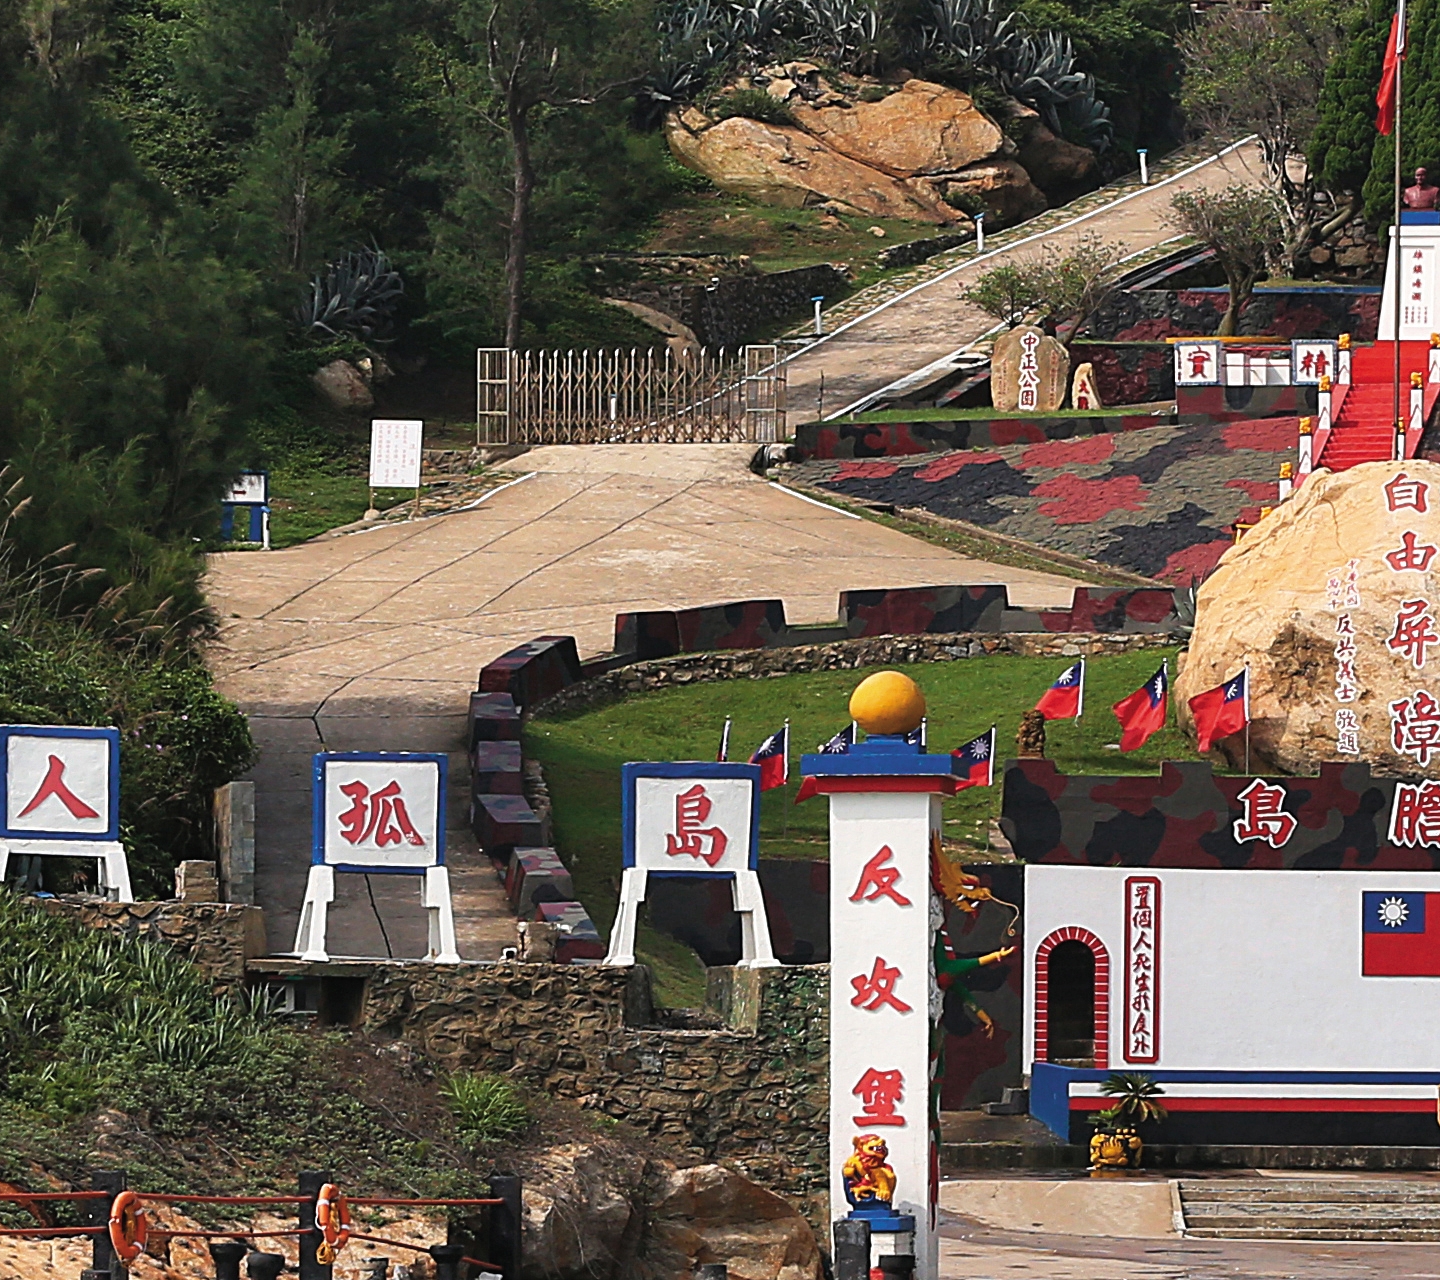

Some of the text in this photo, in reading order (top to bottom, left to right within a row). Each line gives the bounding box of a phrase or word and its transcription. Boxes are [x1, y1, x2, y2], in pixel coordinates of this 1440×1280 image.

[1019, 333, 1039, 408] 中正公園
[17, 754, 100, 820] 人
[338, 780, 426, 848] 孤
[666, 783, 728, 868] 島
[848, 843, 913, 1128] 反攻堡
